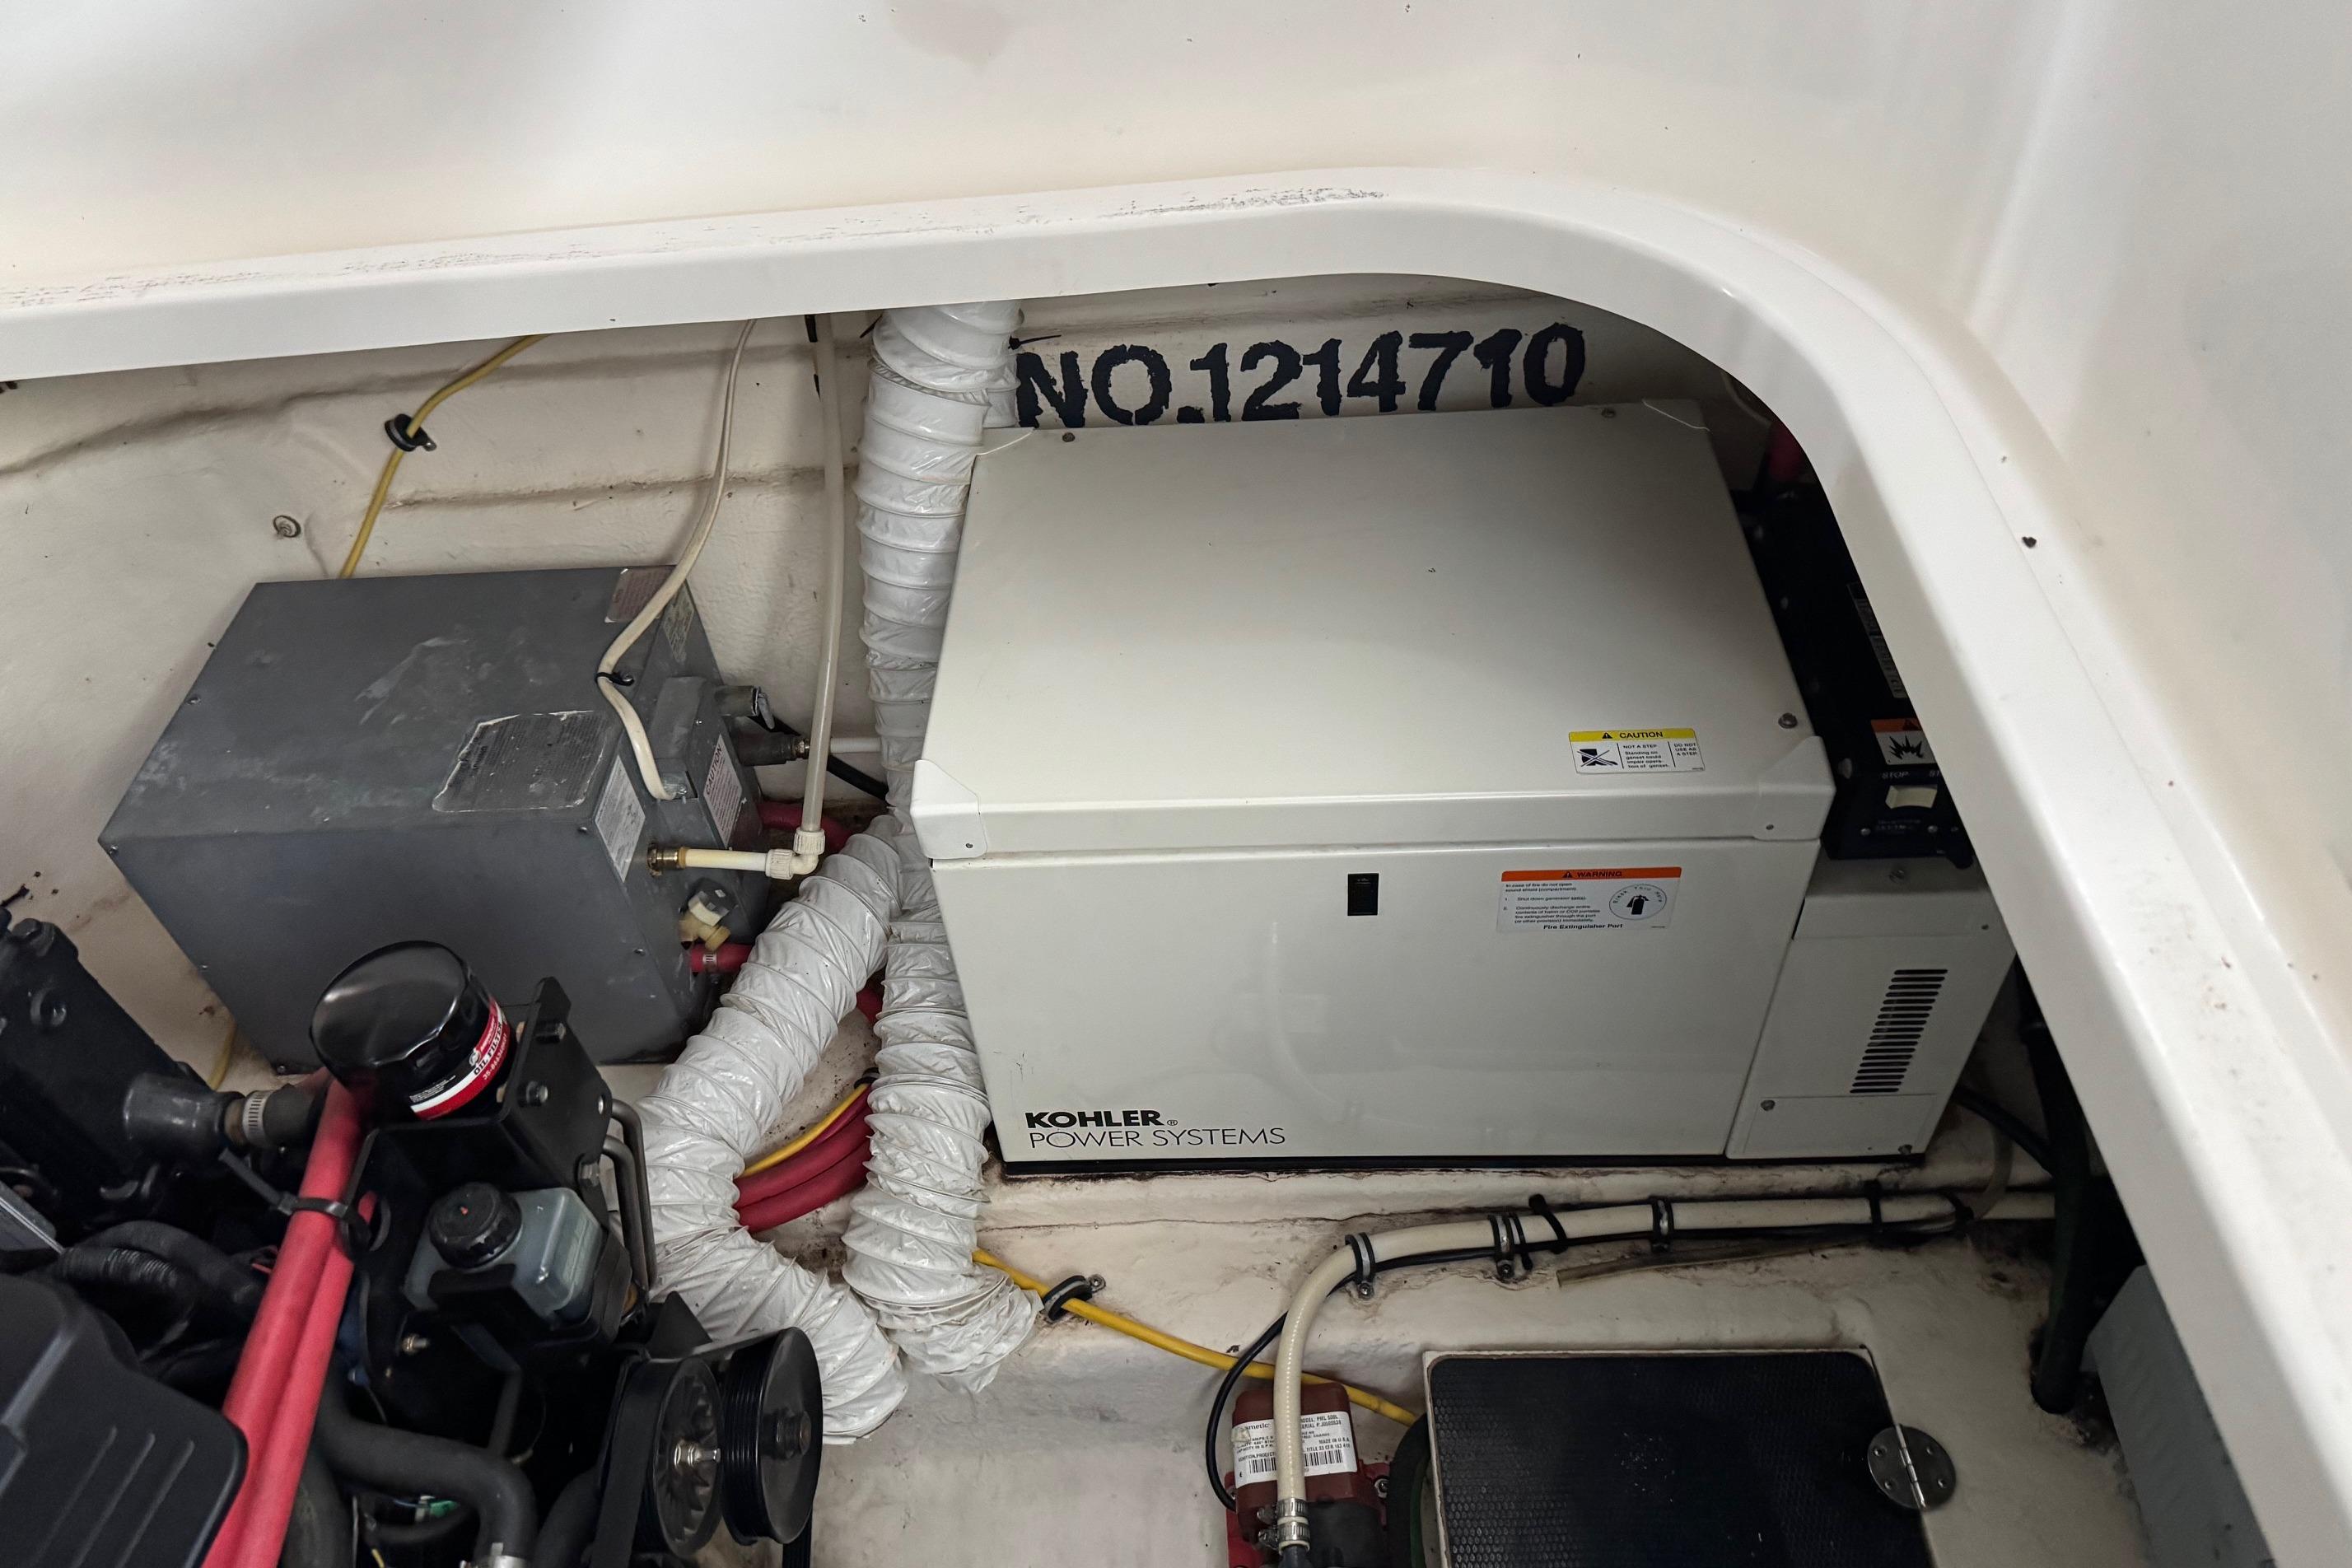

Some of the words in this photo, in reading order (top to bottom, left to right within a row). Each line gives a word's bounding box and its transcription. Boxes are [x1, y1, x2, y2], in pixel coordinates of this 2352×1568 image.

[1018, 322, 1585, 428] NO.1214710
[704, 744, 723, 796] CAUTION
[474, 1056, 489, 1076] OIL
[1025, 1109, 1164, 1128] KOHLER
[1029, 1131, 1144, 1149] POWER
[1153, 1127, 1286, 1146] SYSTEMS
